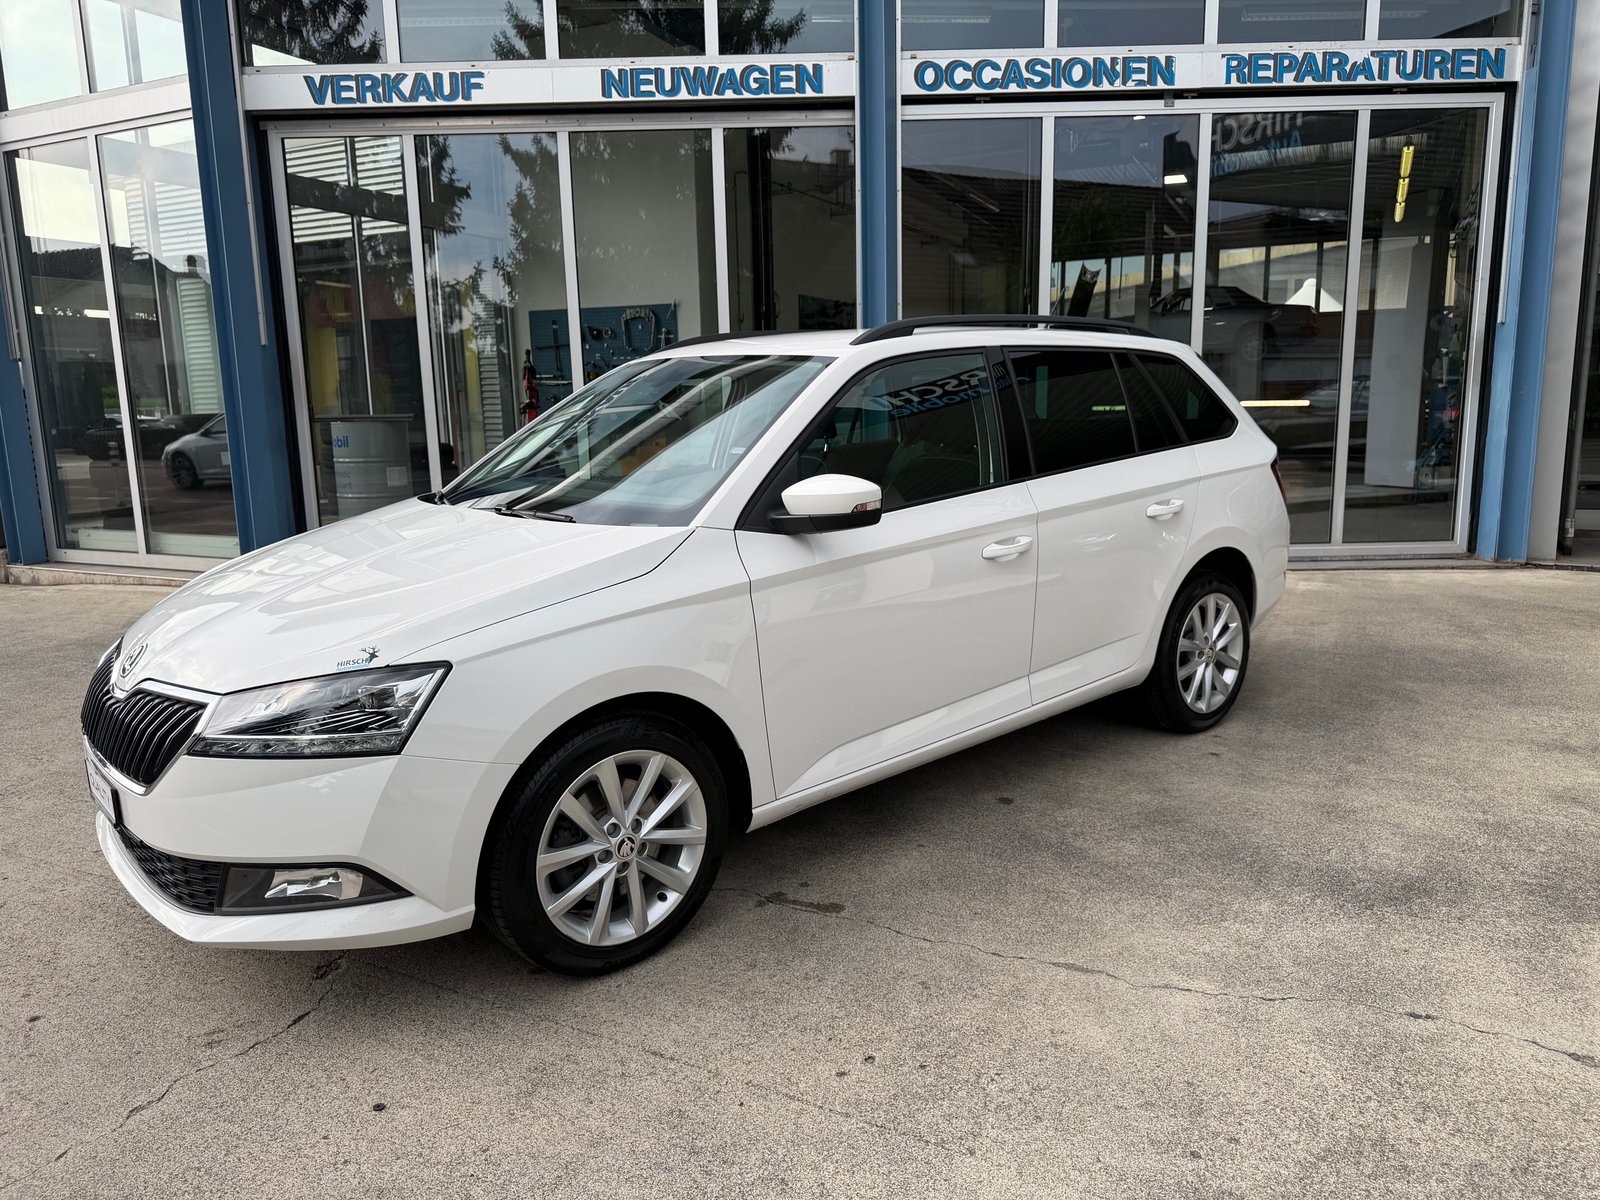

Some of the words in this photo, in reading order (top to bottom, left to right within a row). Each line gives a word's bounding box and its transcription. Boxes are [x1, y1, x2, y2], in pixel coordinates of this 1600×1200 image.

[600, 63, 824, 98] NEUWAGEN
[914, 55, 1176, 92] OCCASIONEN
[1221, 48, 1506, 84] REPARATUREN
[303, 71, 485, 105] VERKAUF
[336, 657, 368, 668] HIRSCH
